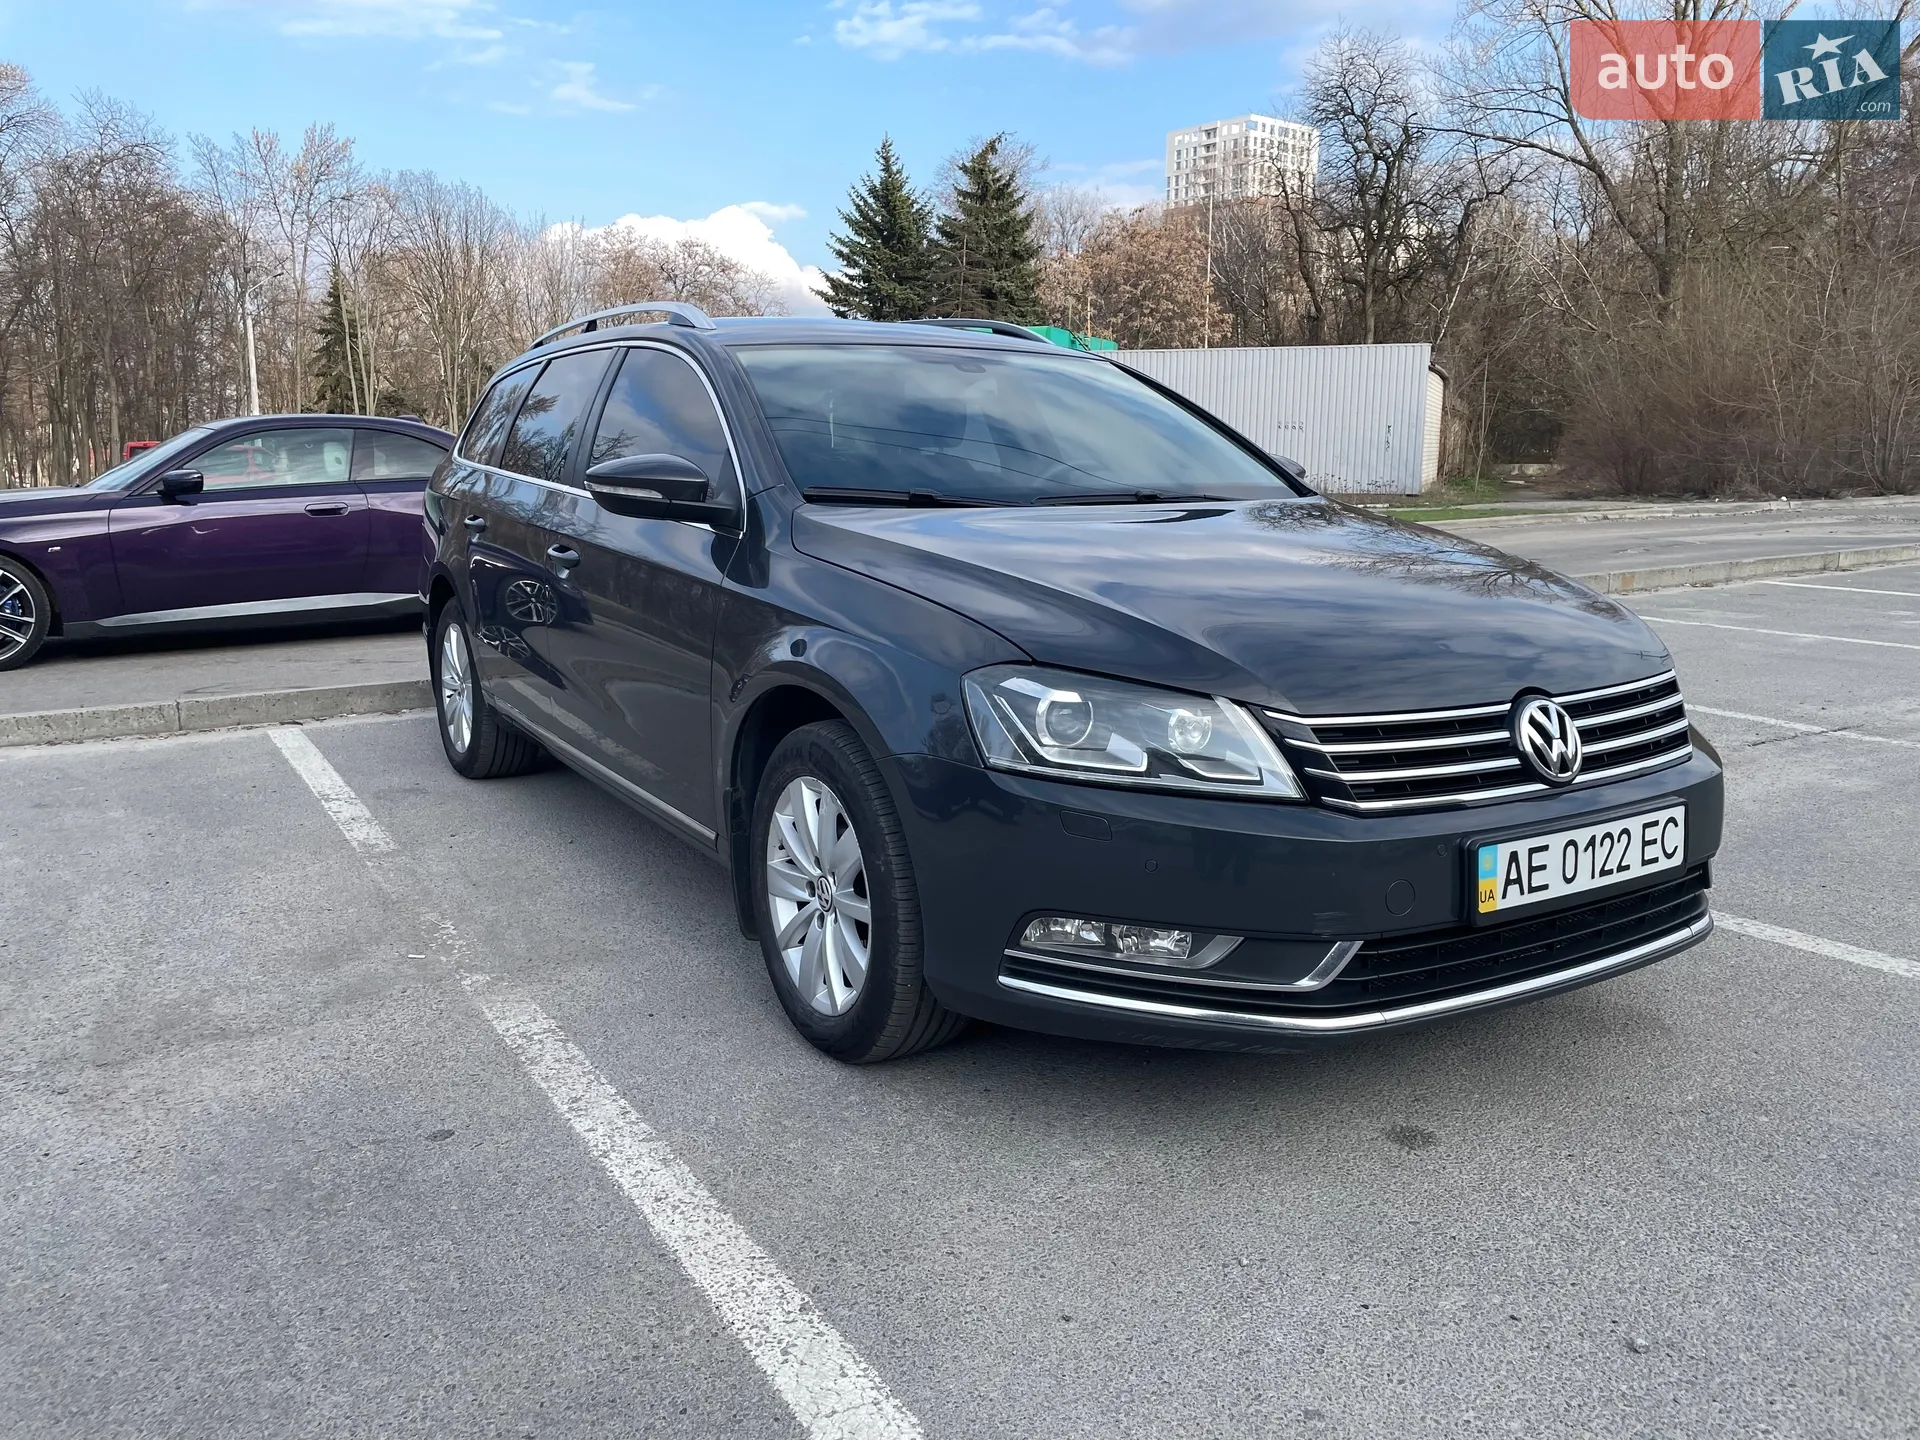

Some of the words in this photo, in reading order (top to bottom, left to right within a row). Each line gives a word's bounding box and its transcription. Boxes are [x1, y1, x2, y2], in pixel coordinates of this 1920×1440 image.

[1501, 843, 1549, 899] AE
[1562, 827, 1632, 884] 0122
[1641, 816, 1680, 867] EC
[1479, 889, 1495, 904] UA
